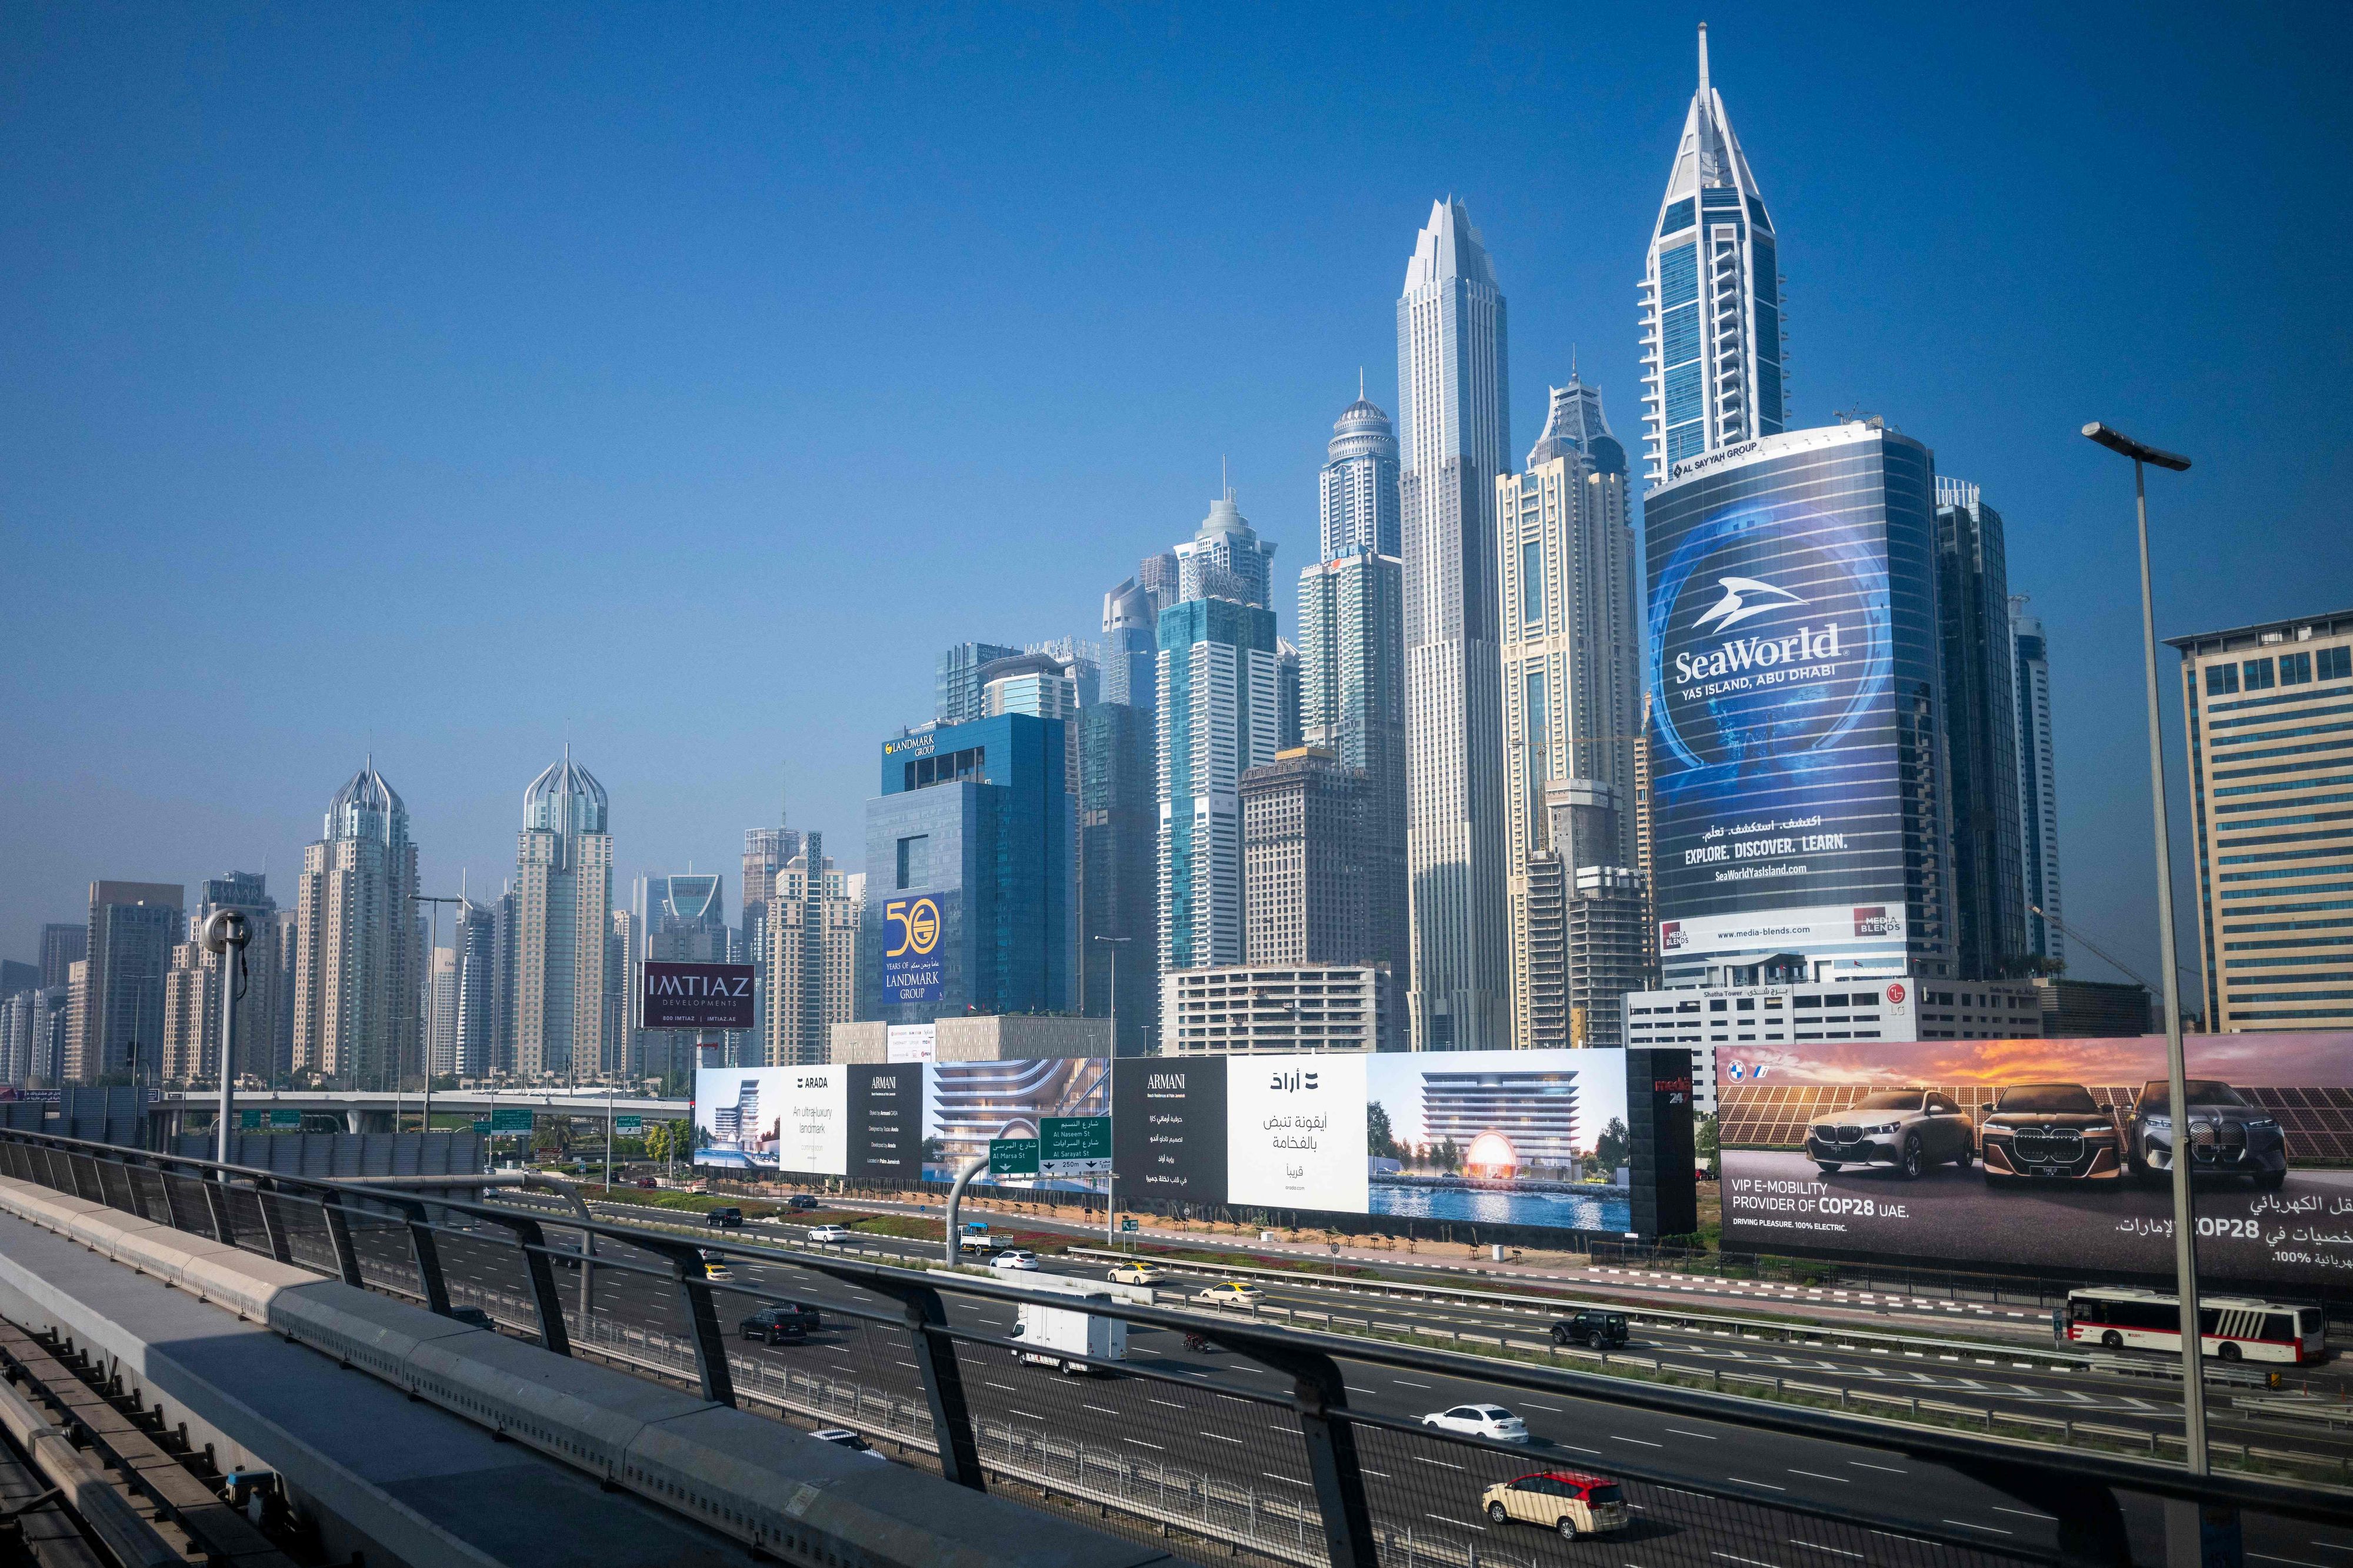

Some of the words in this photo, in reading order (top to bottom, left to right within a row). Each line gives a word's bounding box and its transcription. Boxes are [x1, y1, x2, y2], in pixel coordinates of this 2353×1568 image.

[1683, 466, 1692, 474] AL
[1695, 452, 1725, 469] SAYYAH
[1727, 442, 1757, 458] GROUP
[1302, 563, 1320, 573] TIGER
[1203, 569, 1241, 592] MAG
[1676, 623, 1842, 684] SeaWorld
[1682, 686, 1702, 700] YAS
[1705, 678, 1752, 696] ISLAND,
[1756, 670, 1785, 686] ABU
[1789, 664, 1835, 680] DHABI
[893, 734, 934, 752] LANDMARK
[915, 745, 935, 756] GROUP
[1728, 820, 1774, 836] استكشف.
[1779, 815, 1821, 830] اكتشف.
[1685, 845, 1730, 865] EXPLORE.
[1735, 838, 1795, 858] DISCOVER.
[1802, 833, 1848, 852] LEARN.
[1715, 864, 1807, 881] SeaWorldYasIsland.com
[211, 884, 259, 899] EMAAR
[1718, 926, 1810, 939] www.media-blends.com
[1861, 924, 1900, 932] BLENDS
[1666, 938, 1688, 946] BLENDS
[649, 976, 749, 997] IMTIAZ
[886, 972, 939, 987] LANDMARK
[900, 988, 925, 999] GROUP
[1890, 1005, 1905, 1016] LG
[805, 1077, 828, 1088] ARADA
[871, 1076, 896, 1089] ARMANI
[1147, 1074, 1185, 1089] ARMANI
[1655, 1077, 1692, 1092] media
[793, 1106, 801, 1117] An
[802, 1106, 832, 1120] ultra-luxury
[799, 1123, 825, 1133] landmark
[1061, 1120, 1080, 1129] النسيم
[1082, 1120, 1099, 1129] شارع
[1264, 1115, 1291, 1130] تنبض
[1295, 1112, 1327, 1132] أيقونة
[1019, 1142, 1036, 1150] شارع
[1053, 1139, 1080, 1147] السرايات
[1082, 1139, 1099, 1148] شارع
[1273, 1135, 1317, 1153] بالفخامة
[1180, 1177, 1187, 1186] في
[1731, 1179, 1751, 1193] VIP
[1755, 1180, 1828, 1196] E-MOBILITY
[1733, 1196, 1795, 1212] PROVIDER
[1798, 1199, 1816, 1212] OF
[1819, 1197, 1875, 1216] COP28
[1879, 1205, 1909, 1219] UAE.
[2250, 1194, 2322, 1216] الكهربائي
[1733, 1218, 1758, 1226] DRIVING
[1759, 1219, 1794, 1229] PLEASURE.
[1795, 1222, 1813, 1230] 100%
[1814, 1223, 1847, 1232] ELECTRIC.
[2115, 1218, 2177, 1238] لإمارات.
[2195, 1217, 2259, 1239] OP28
[2266, 1226, 2286, 1247] في
